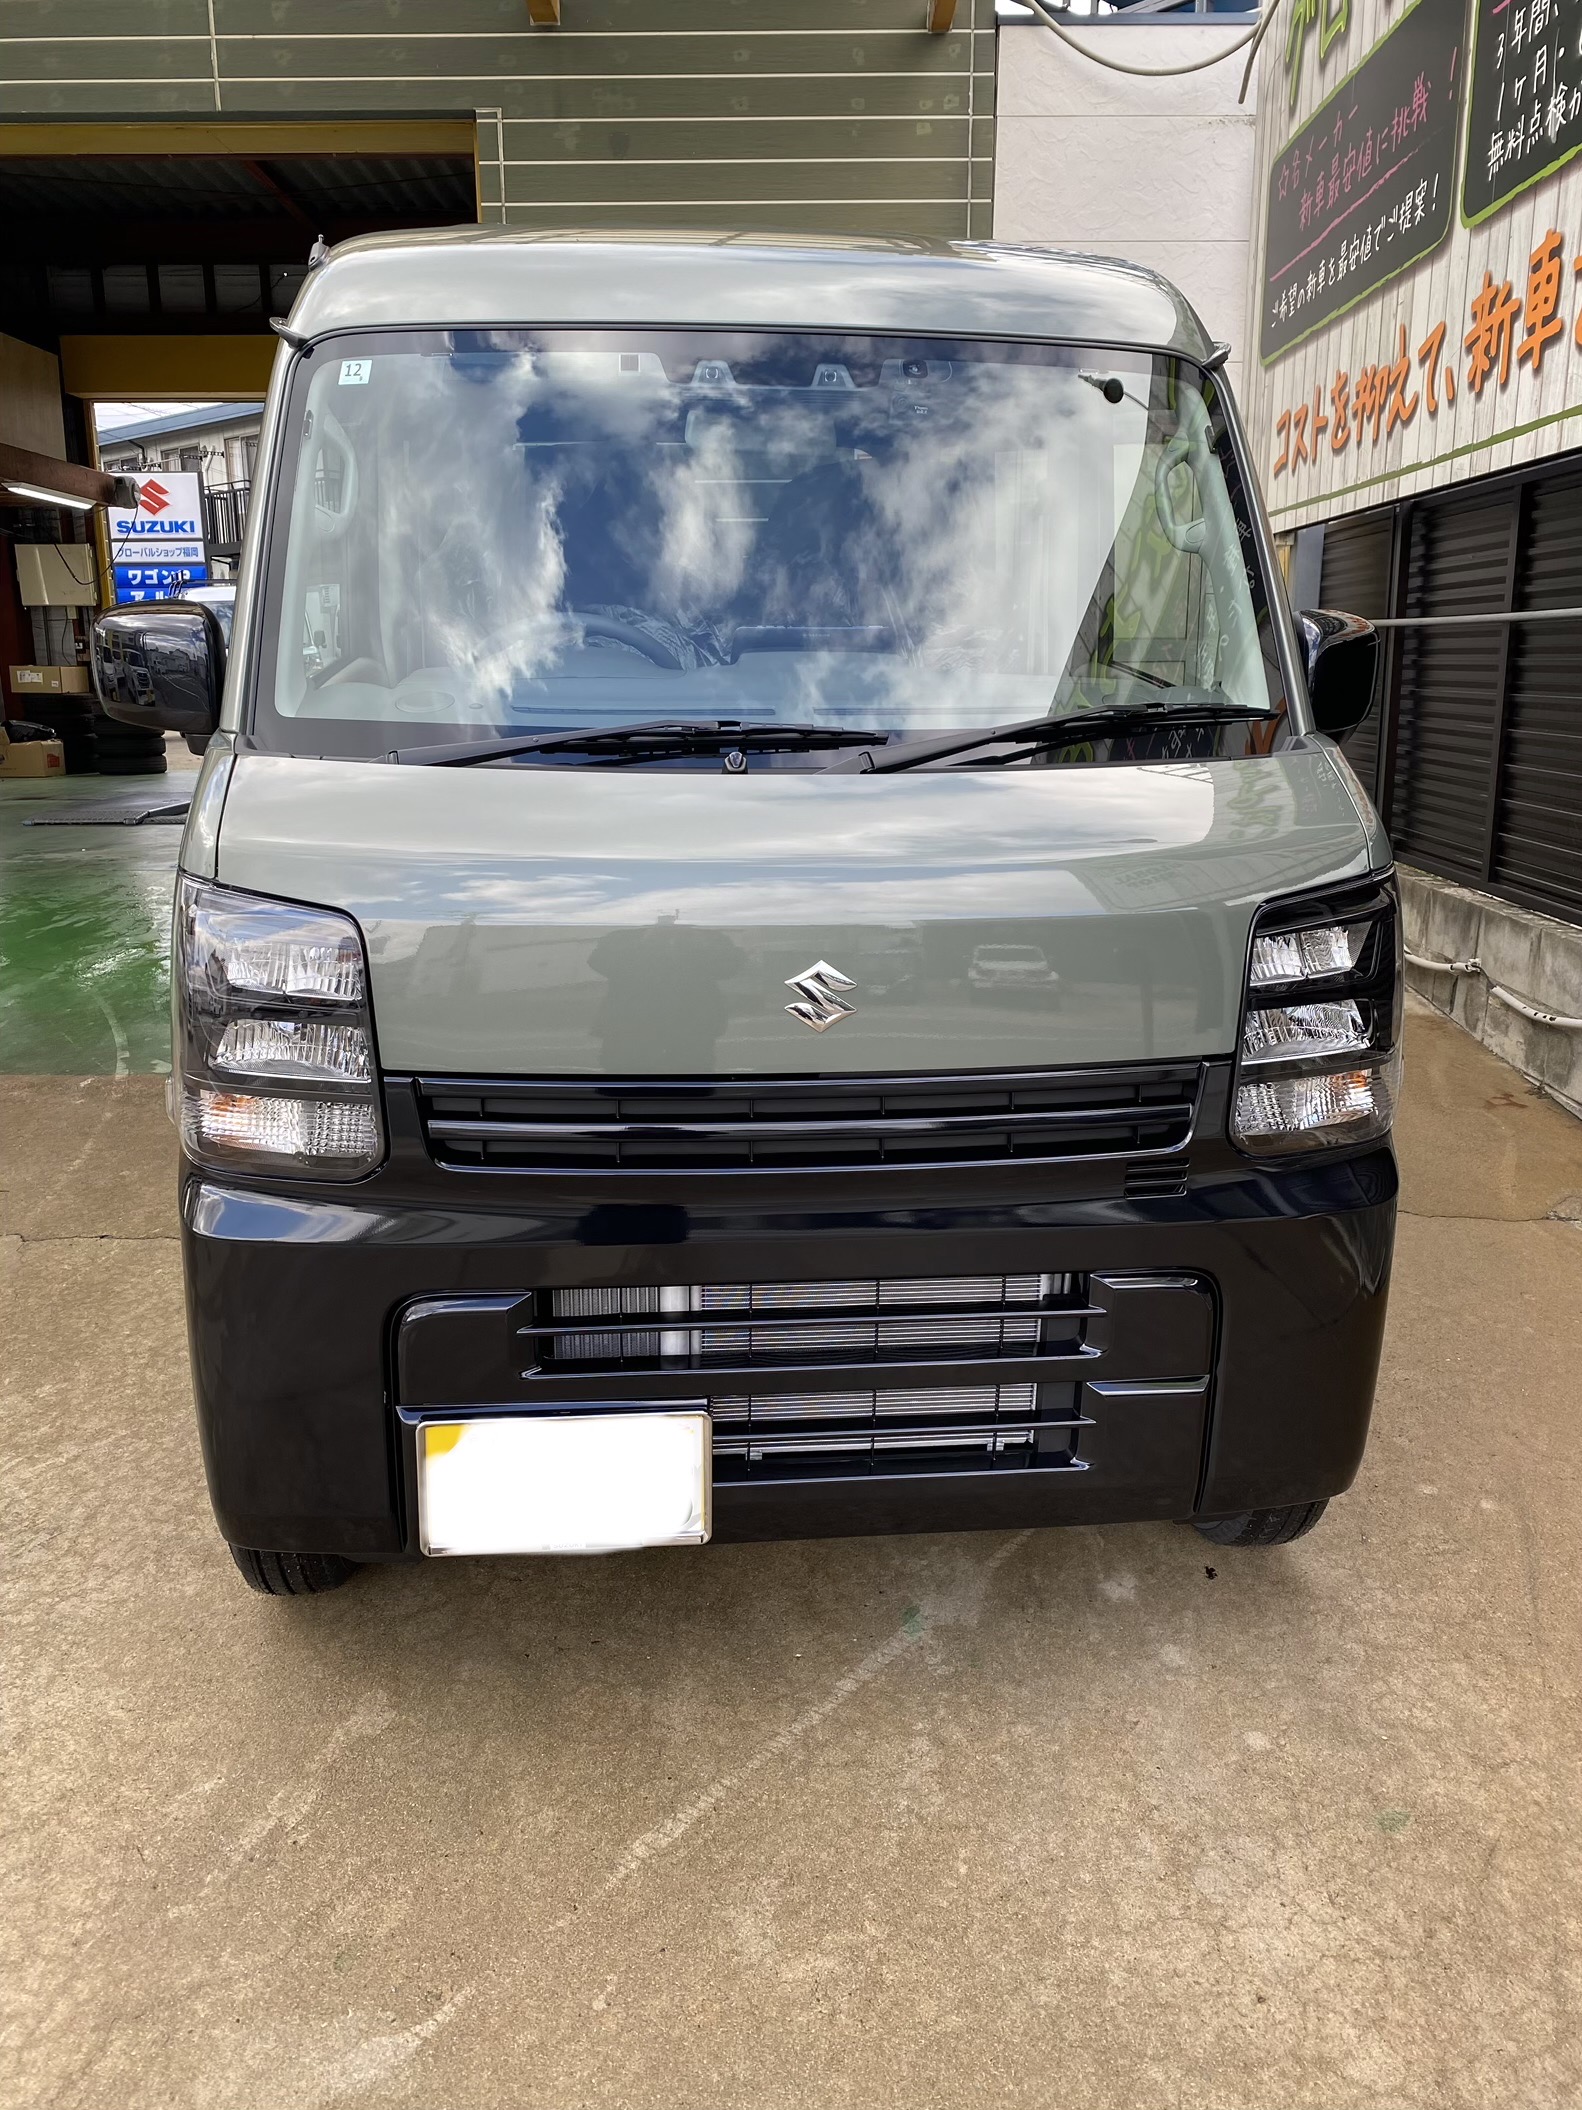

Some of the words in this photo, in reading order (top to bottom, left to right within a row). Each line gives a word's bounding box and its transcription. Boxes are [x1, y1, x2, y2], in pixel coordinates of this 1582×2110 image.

[1497, 29, 1582, 121] 1ヶ月・
[1271, 172, 1439, 328] ご希望の新車を最安値でご提案！
[344, 363, 362, 377] 12
[1273, 228, 1582, 475] コストを抑えて、新車
[116, 520, 195, 533] SUZUKI
[117, 546, 199, 558] グローバルショップ福岡
